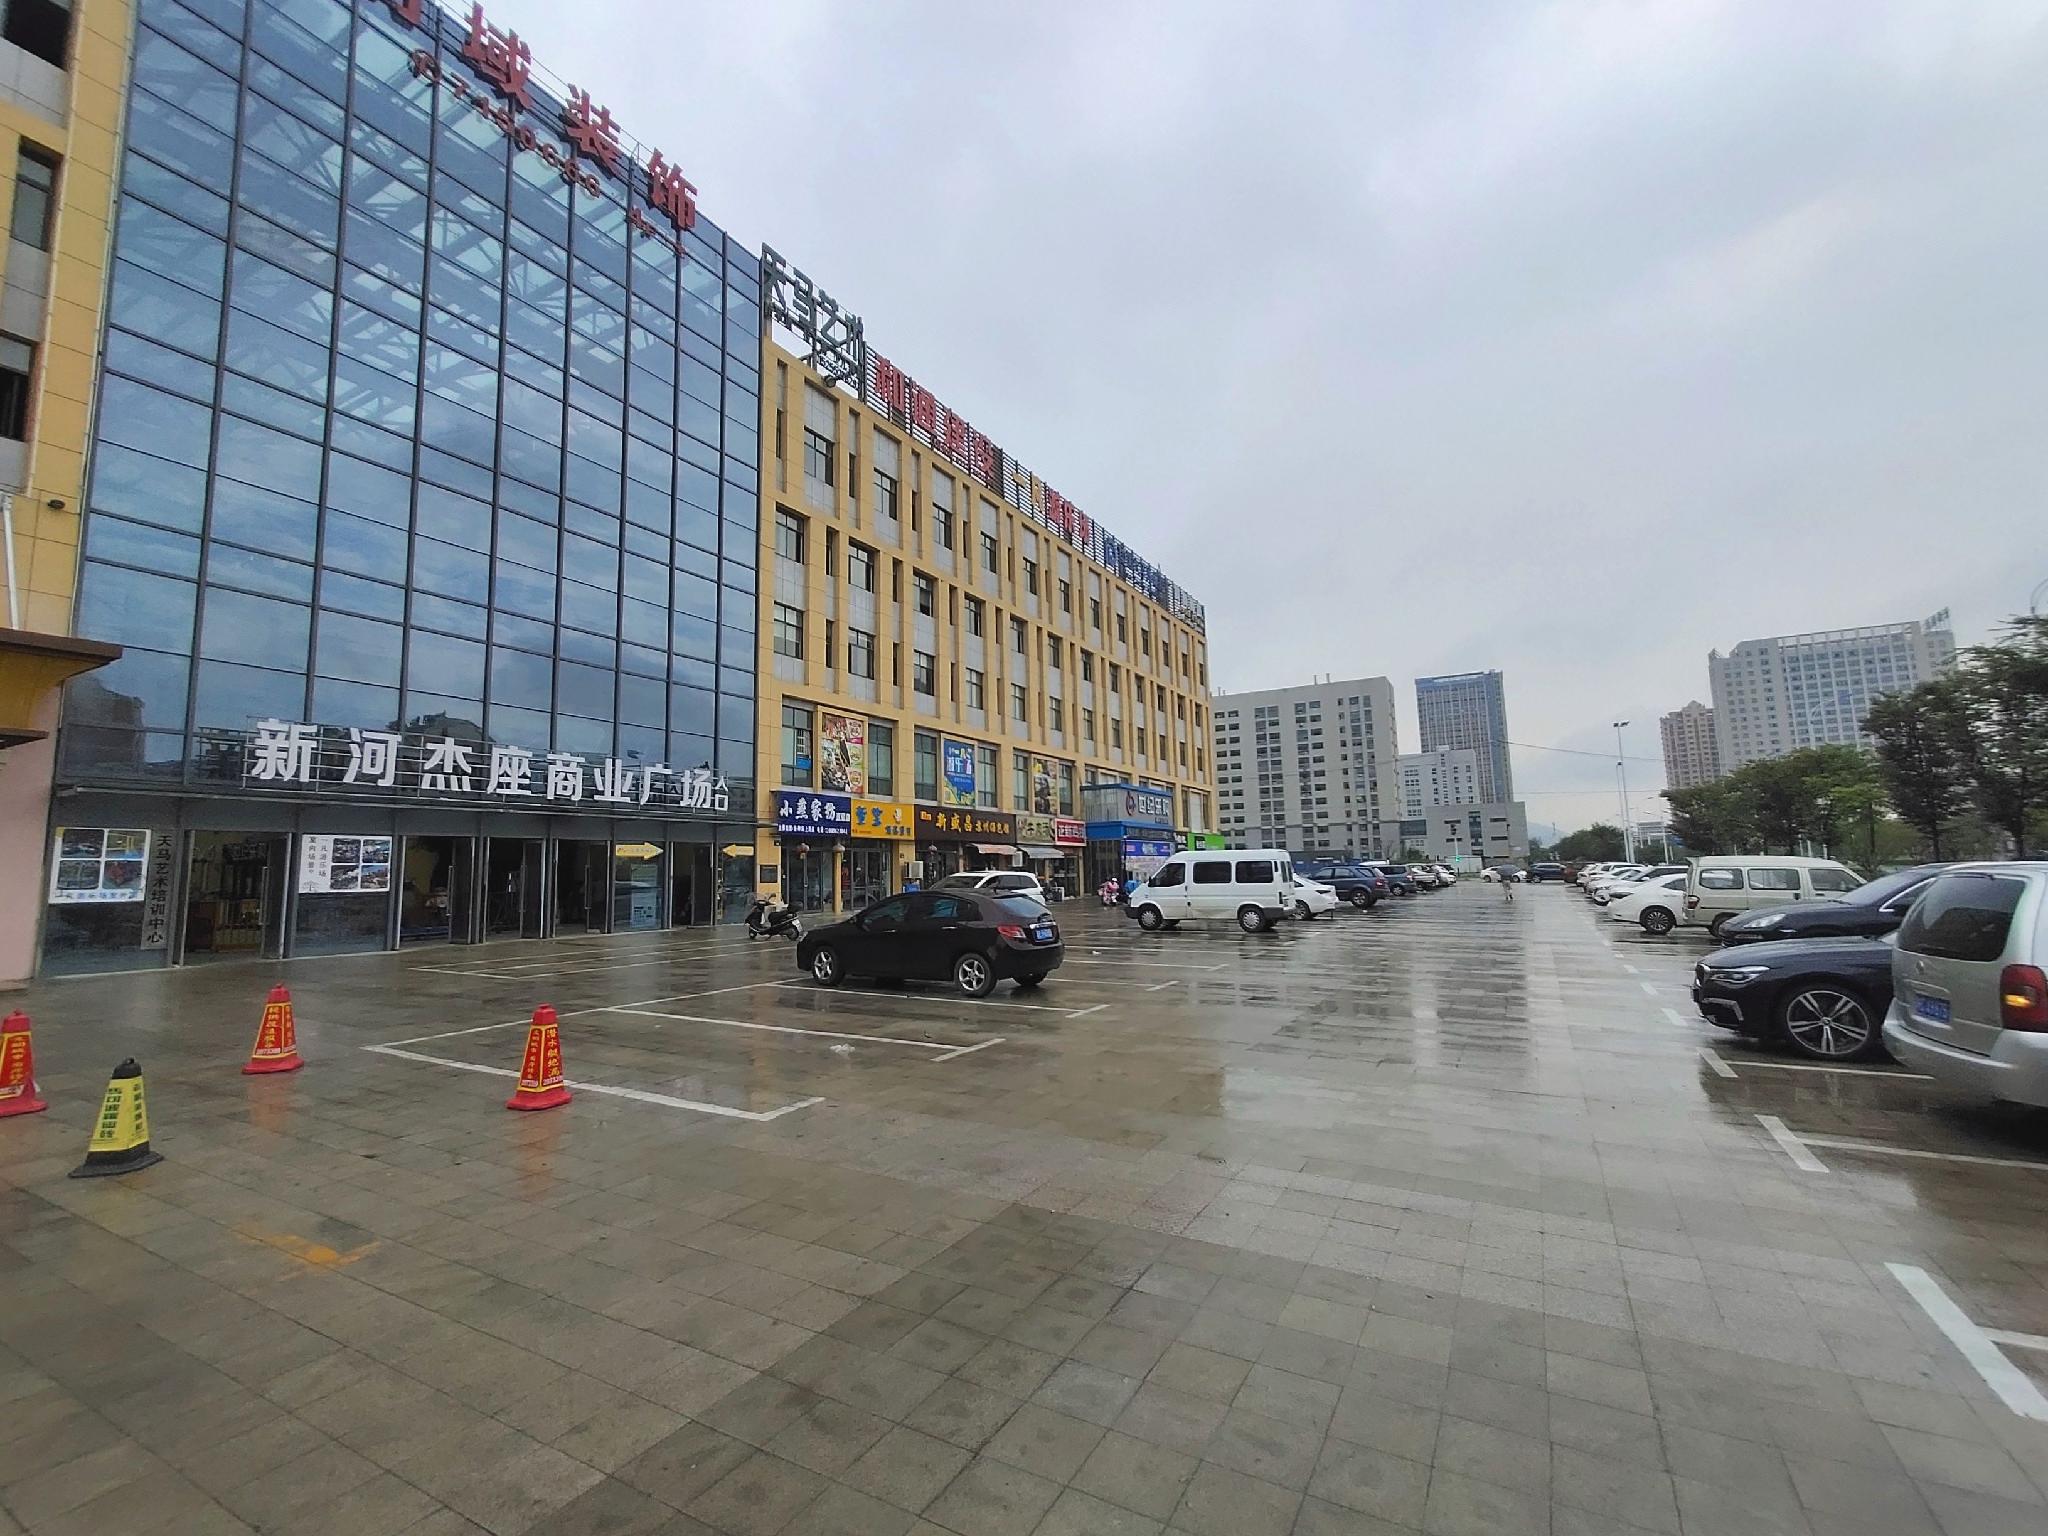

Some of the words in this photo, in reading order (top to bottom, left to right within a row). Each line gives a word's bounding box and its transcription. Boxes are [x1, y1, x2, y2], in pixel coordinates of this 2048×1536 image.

[251, 718, 712, 808] 新河杰座商业广场
[147, 835, 173, 943] 天马艺术培训中心
